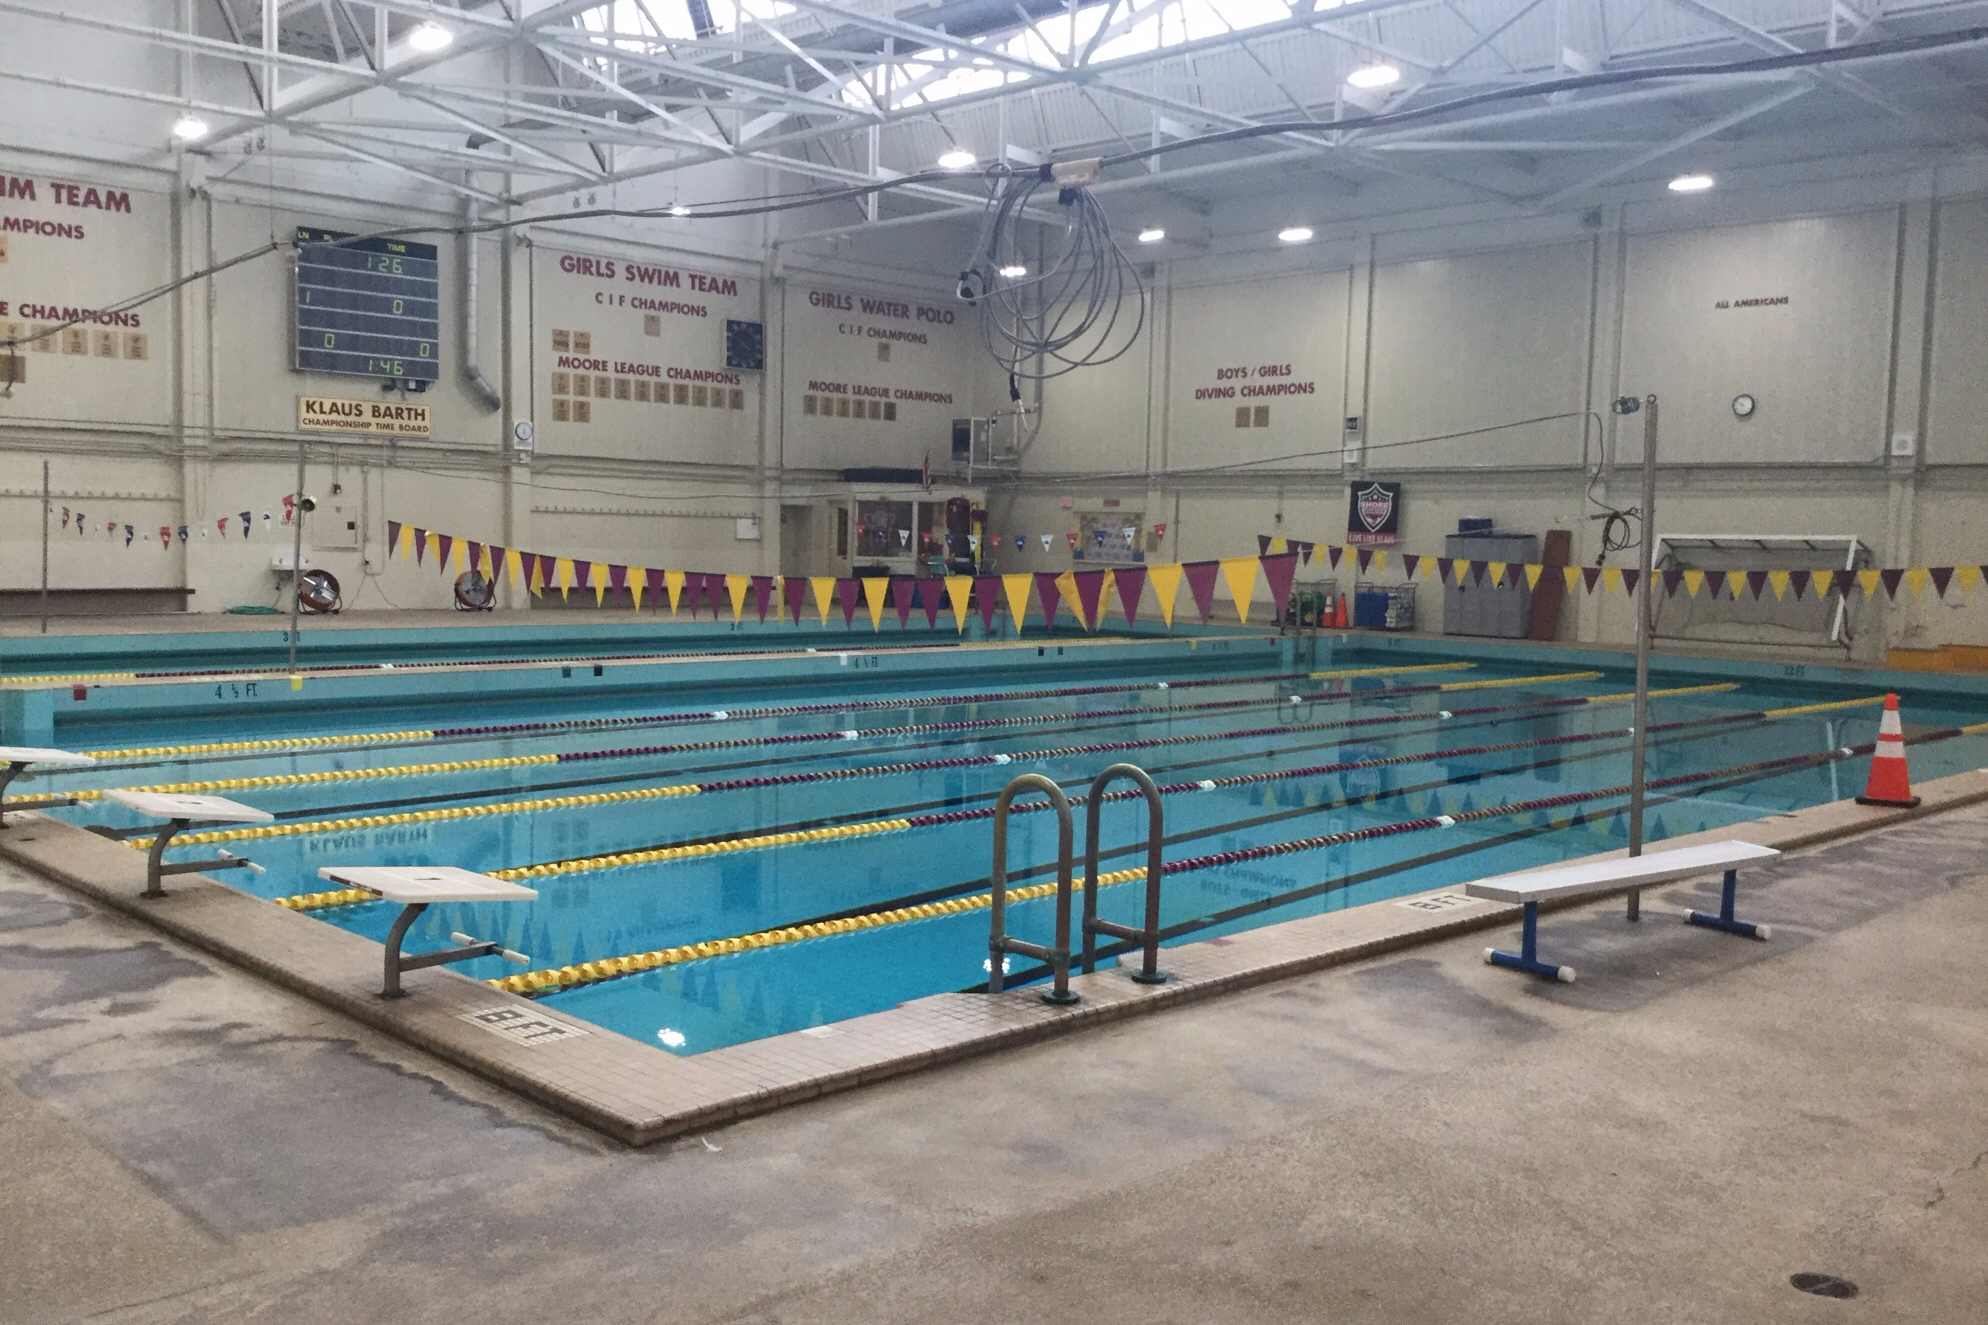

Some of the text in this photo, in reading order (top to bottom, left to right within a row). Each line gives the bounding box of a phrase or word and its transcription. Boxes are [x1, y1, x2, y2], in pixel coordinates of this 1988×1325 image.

[50, 182, 131, 214] TEAM
[0, 216, 85, 240] MPIONS
[559, 255, 738, 297] GIRLS SWIM TEAM
[631, 297, 708, 318] CHAMPIONS
[809, 291, 955, 325] GIRLS WATER POLO
[1734, 296, 1788, 308] AMERICANS
[19, 303, 140, 328] CHAMPIONS
[867, 327, 928, 344] CHAMPIONS
[558, 356, 741, 385] MOORE LEAGUE CHAMPIONS
[1217, 367, 1248, 380] BOYS
[1258, 364, 1292, 377] GIRLS
[808, 380, 953, 404] MOORE LEAGUE CHAMPIONS
[1195, 382, 1315, 400] DIVING CHAMPIONS
[305, 400, 426, 422] KLAUS BARTH
[302, 418, 429, 433] CHAMPIONSHIP TIME BOARD
[215, 684, 223, 698] 4
[503, 1020, 567, 1039] FT
